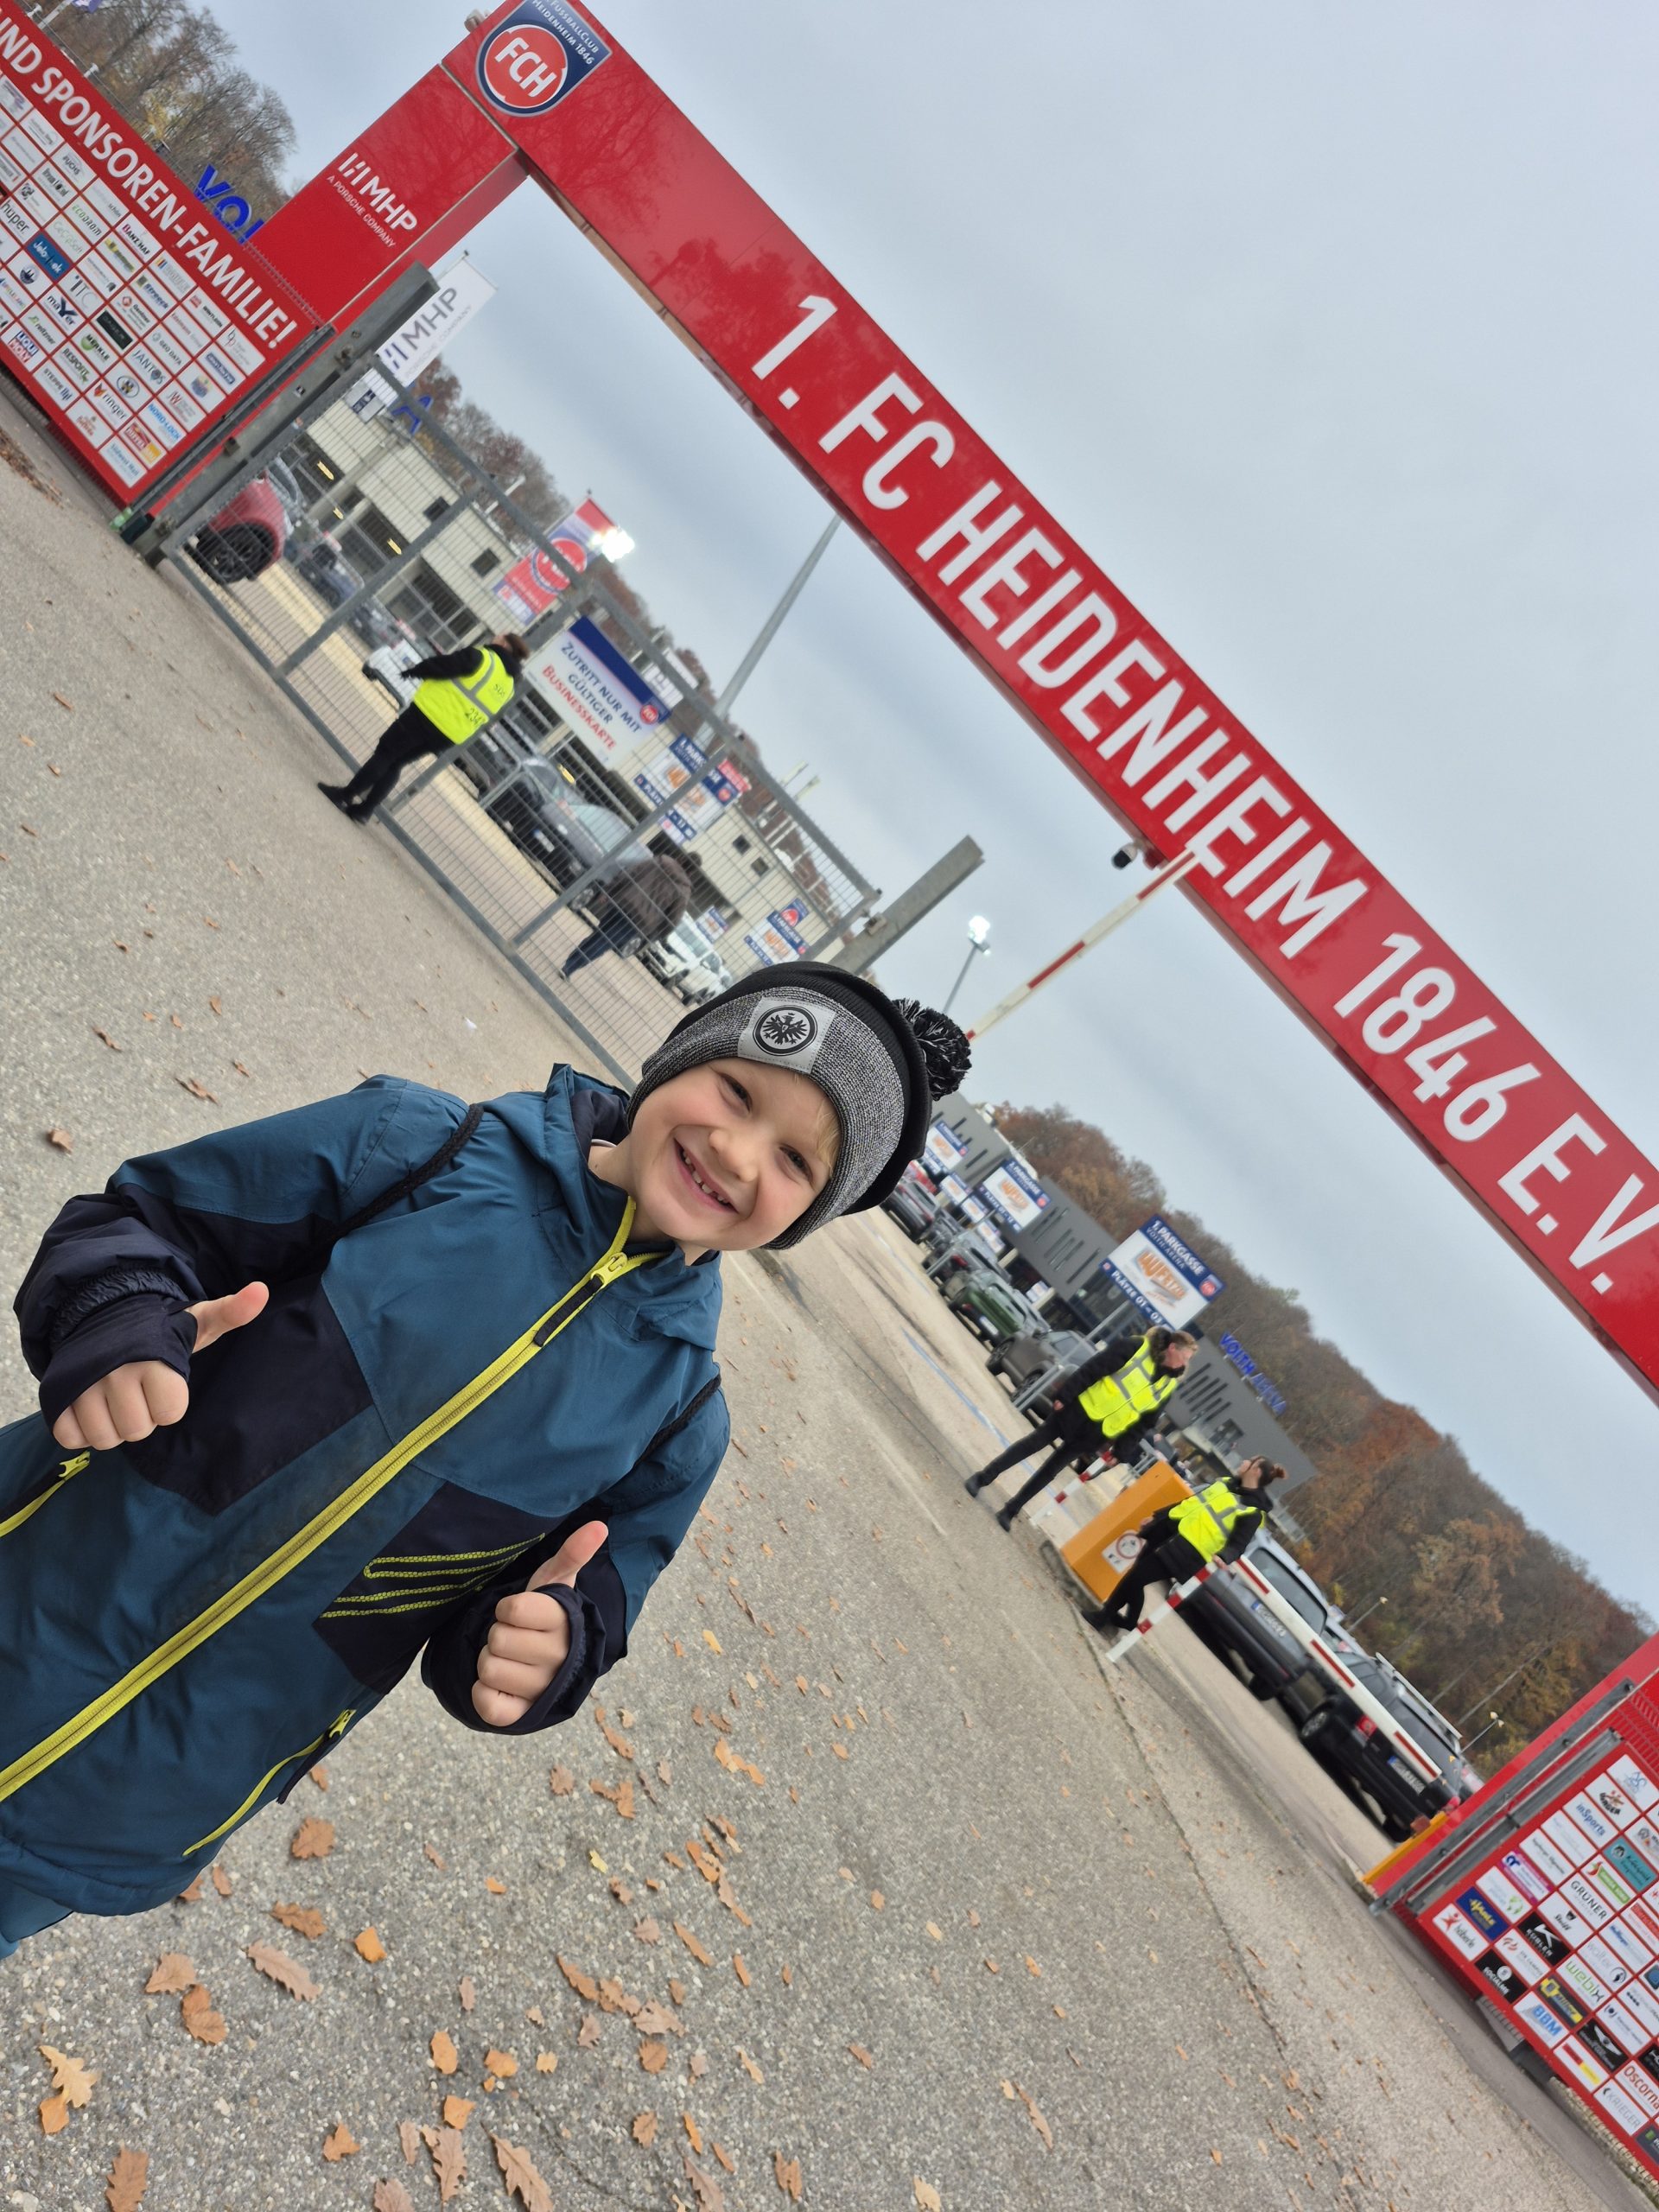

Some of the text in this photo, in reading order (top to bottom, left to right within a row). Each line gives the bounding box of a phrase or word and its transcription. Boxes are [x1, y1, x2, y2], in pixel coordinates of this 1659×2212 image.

[532, 0, 594, 65] HEIDENHEIM 1846
[494, 36, 557, 97] FCH
[0, 16, 297, 349] ND SPONSOREN-FAMILIE!
[359, 175, 418, 229] MHP
[333, 181, 365, 215] PORSCHE
[362, 213, 395, 247] COMPANY
[8, 338, 31, 363] MOLY
[15, 331, 39, 356] LIQUI
[542, 664, 616, 750] BUSINESSKARTE
[560, 642, 642, 734] ZUTRITT NUR MIT
[567, 673, 613, 724] GÜLTIGER
[750, 299, 837, 410] 1.
[817, 371, 957, 509] FC
[914, 480, 1368, 959] HEIDENHEIM
[1336, 938, 1541, 1143] 1846
[1156, 1226, 1205, 1275] PARKGASSE
[1575, 1803, 1606, 1835] inSports
[1565, 1961, 1605, 2002] webix
[1531, 2005, 1562, 2036] BBM
[1623, 2065, 1658, 2109] Oscorna
